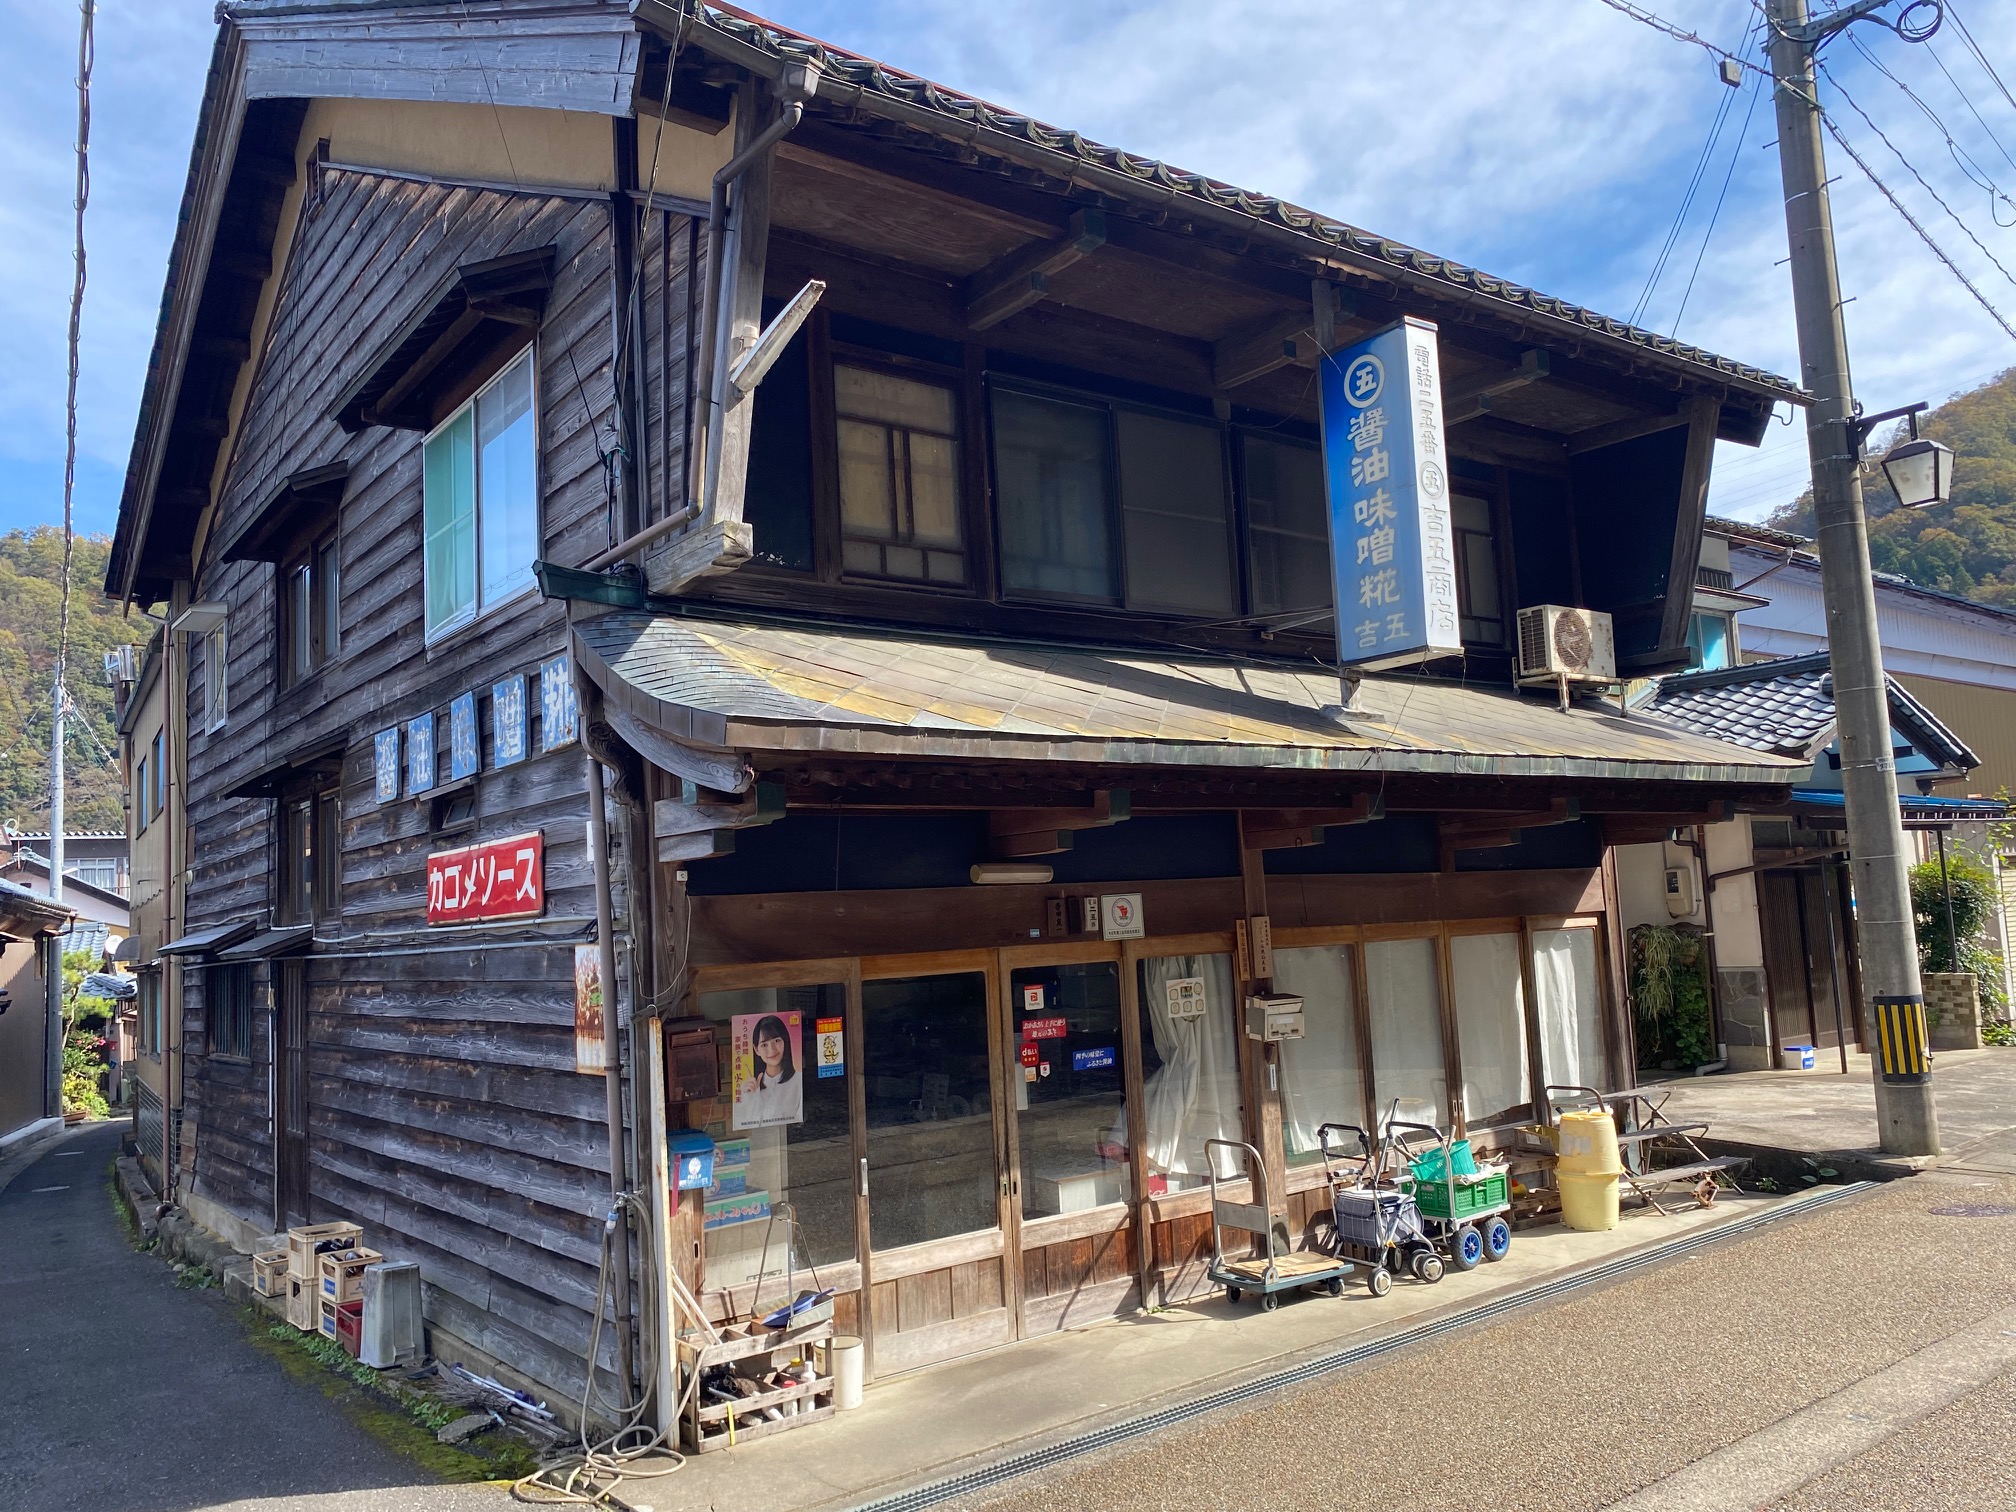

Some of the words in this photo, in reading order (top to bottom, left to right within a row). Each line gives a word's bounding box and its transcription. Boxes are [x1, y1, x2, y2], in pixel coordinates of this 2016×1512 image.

[1414, 344, 1439, 456] 電話二五番
[1422, 503, 1455, 632] 吉五商店
[429, 846, 537, 914] カゴメソース
[734, 1073, 743, 1104] 火の始末
